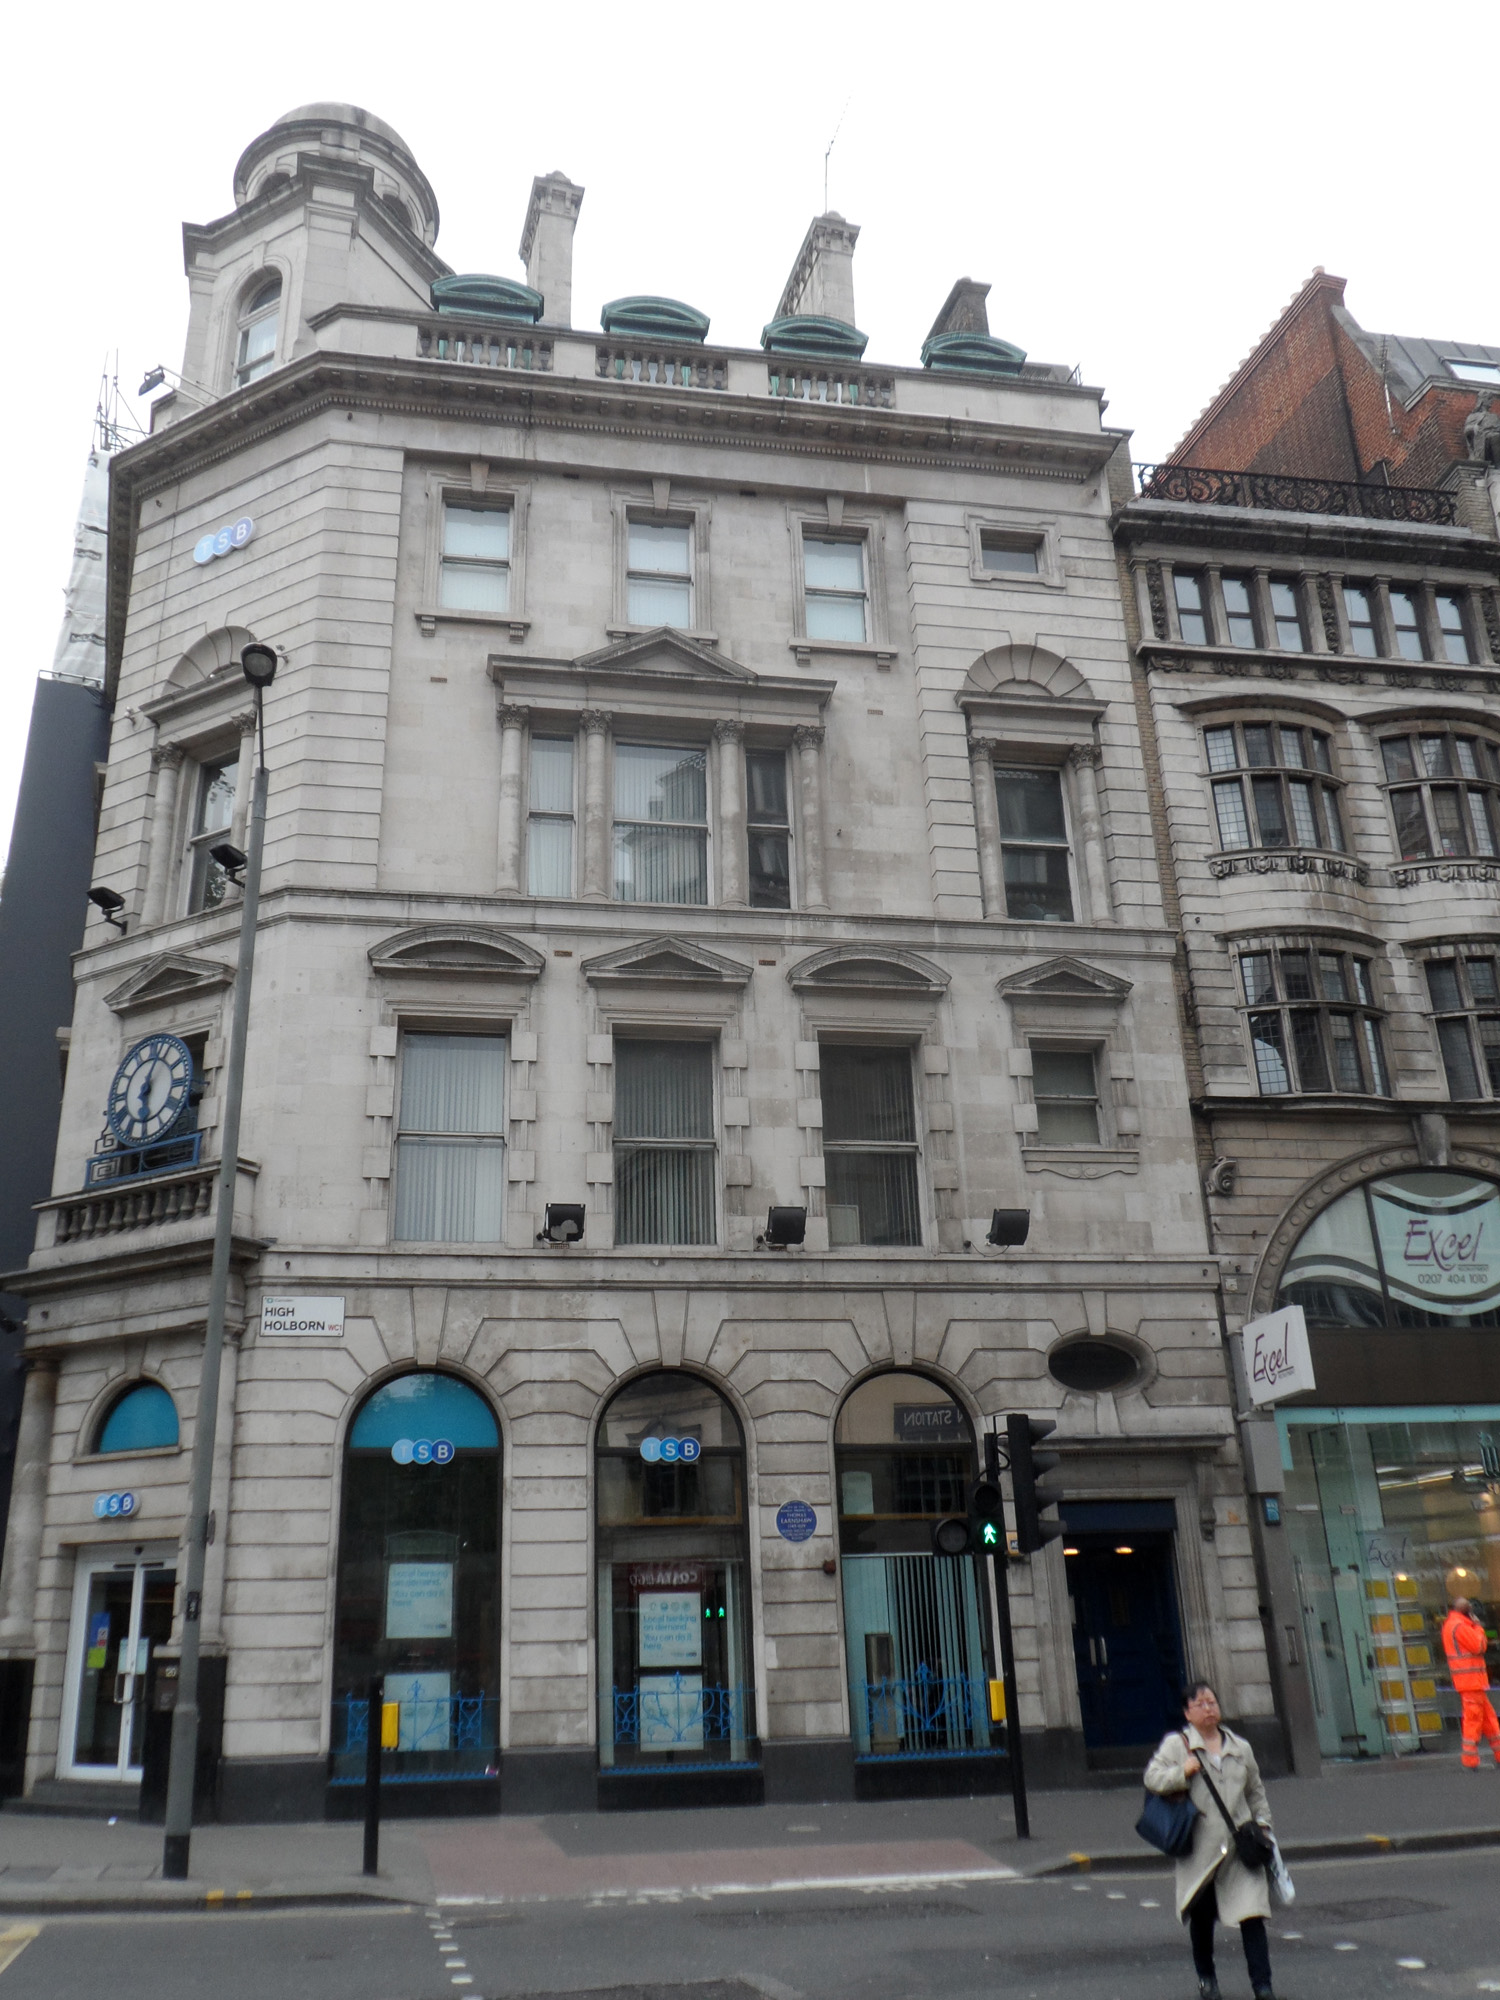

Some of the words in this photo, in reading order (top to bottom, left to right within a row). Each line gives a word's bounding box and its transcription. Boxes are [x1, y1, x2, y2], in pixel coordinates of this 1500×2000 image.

[199, 521, 249, 558] TSB
[1404, 1220, 1484, 1271] Excel
[1418, 1274, 1442, 1284] 0207
[1448, 1274, 1466, 1284] 404
[264, 1307, 295, 1317] HIGH
[263, 1321, 325, 1331] HOLBORN
[1253, 1322, 1288, 1385] Excel
[398, 1442, 450, 1460] TSB
[645, 1441, 697, 1459] TSB
[96, 1496, 133, 1515] TSB
